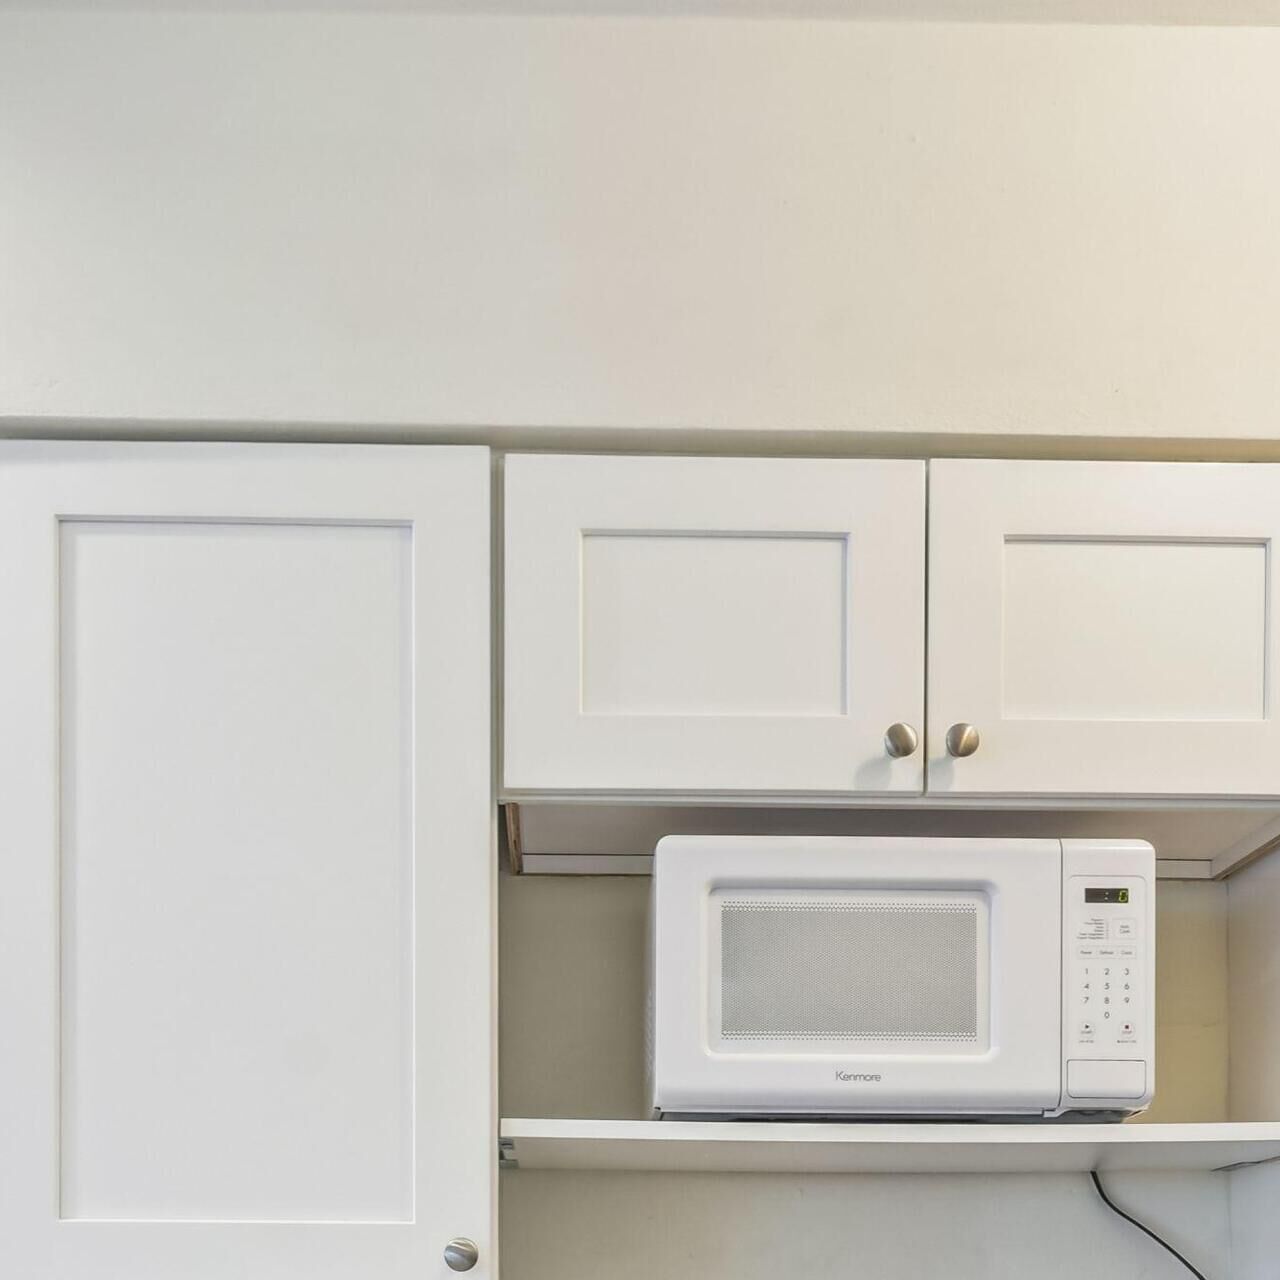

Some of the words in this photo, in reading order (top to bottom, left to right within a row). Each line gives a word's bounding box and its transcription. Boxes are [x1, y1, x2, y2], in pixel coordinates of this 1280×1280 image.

[1104, 967, 1110, 976] 2
[1124, 967, 1130, 976] 3
[1104, 982, 1110, 990] 5
[1124, 982, 1130, 990] 6
[1083, 996, 1090, 1004] 7
[1104, 996, 1110, 1005] 8
[1124, 996, 1130, 1004] 9
[1104, 1011, 1110, 1019] 0
[835, 1070, 881, 1082] Kenmore
